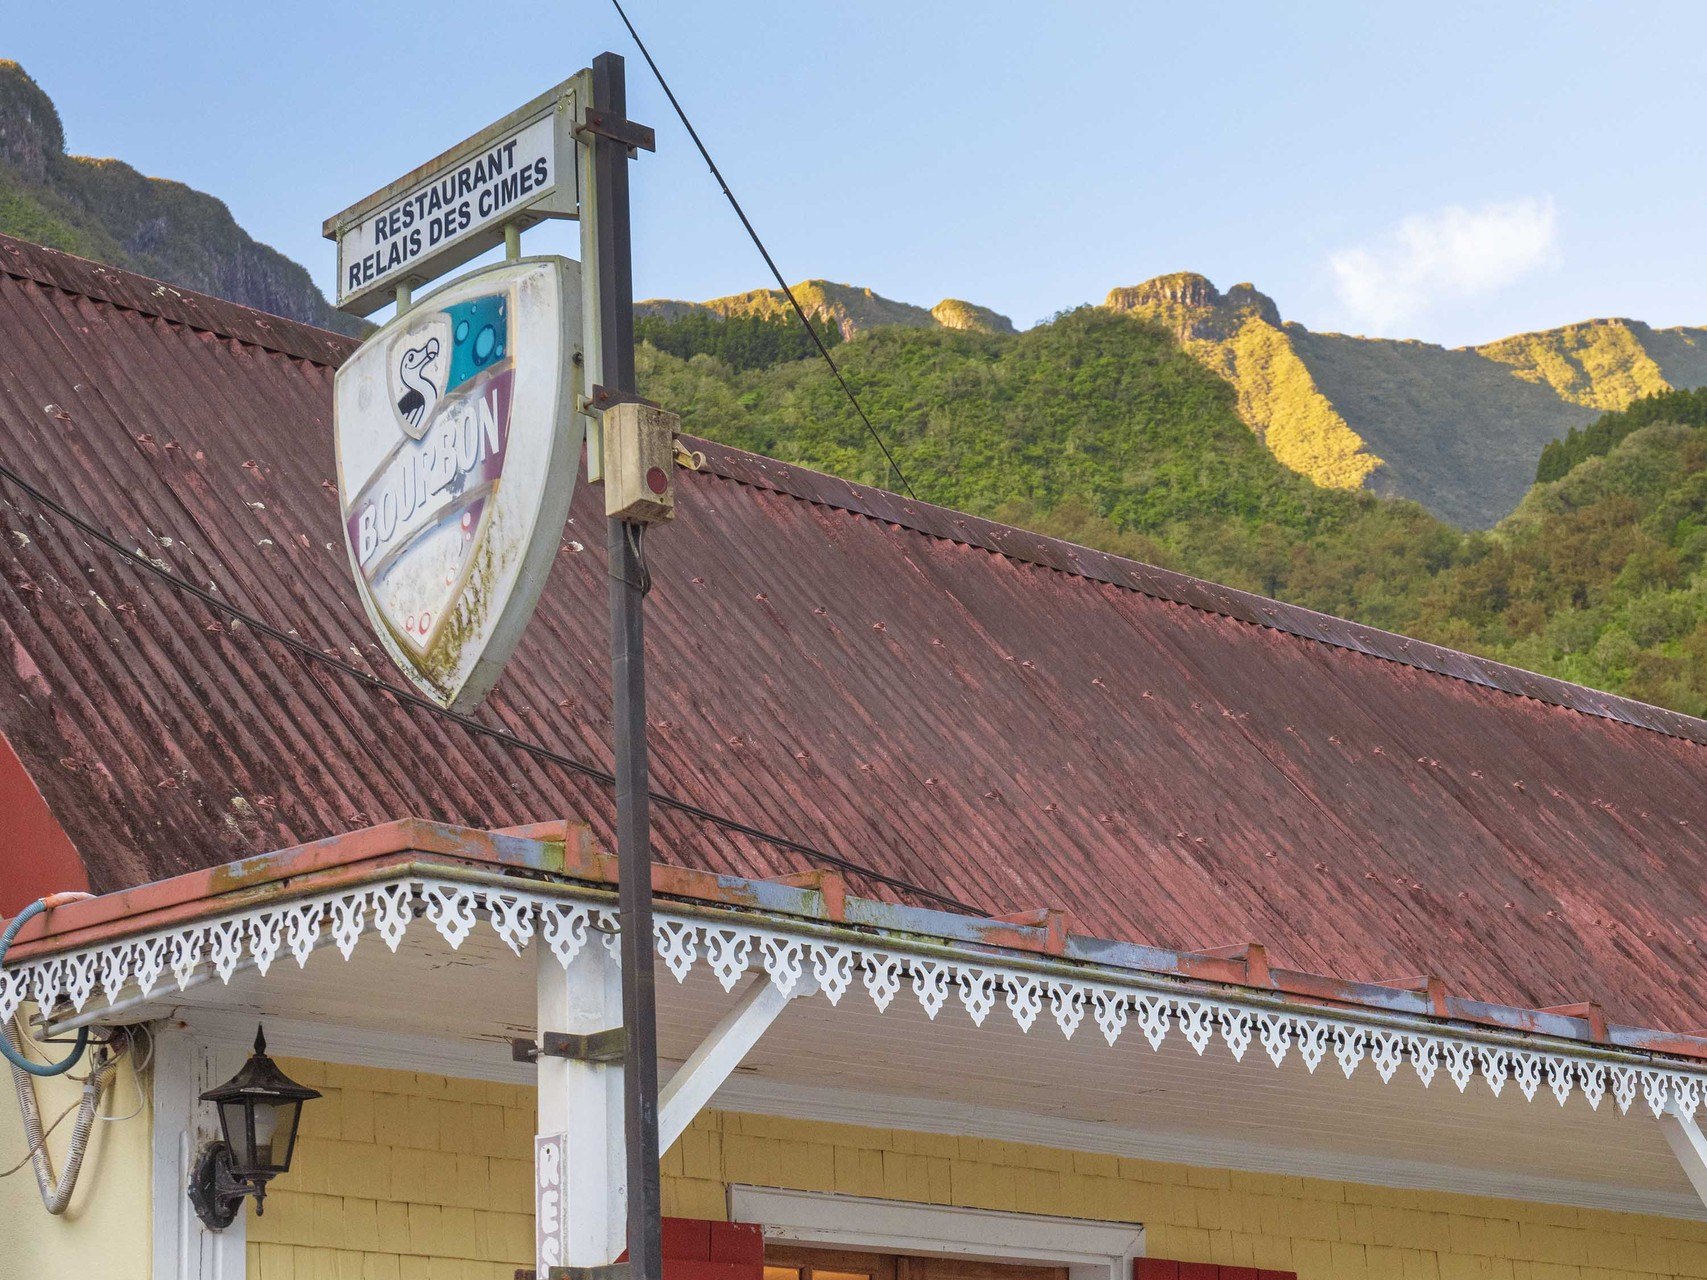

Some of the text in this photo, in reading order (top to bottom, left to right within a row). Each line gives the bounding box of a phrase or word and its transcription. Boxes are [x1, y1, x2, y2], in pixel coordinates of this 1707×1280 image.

[349, 156, 548, 291] RELAIS DES CIMES
[374, 139, 517, 245] RESTAURANT
[358, 388, 500, 568] BOURBON
